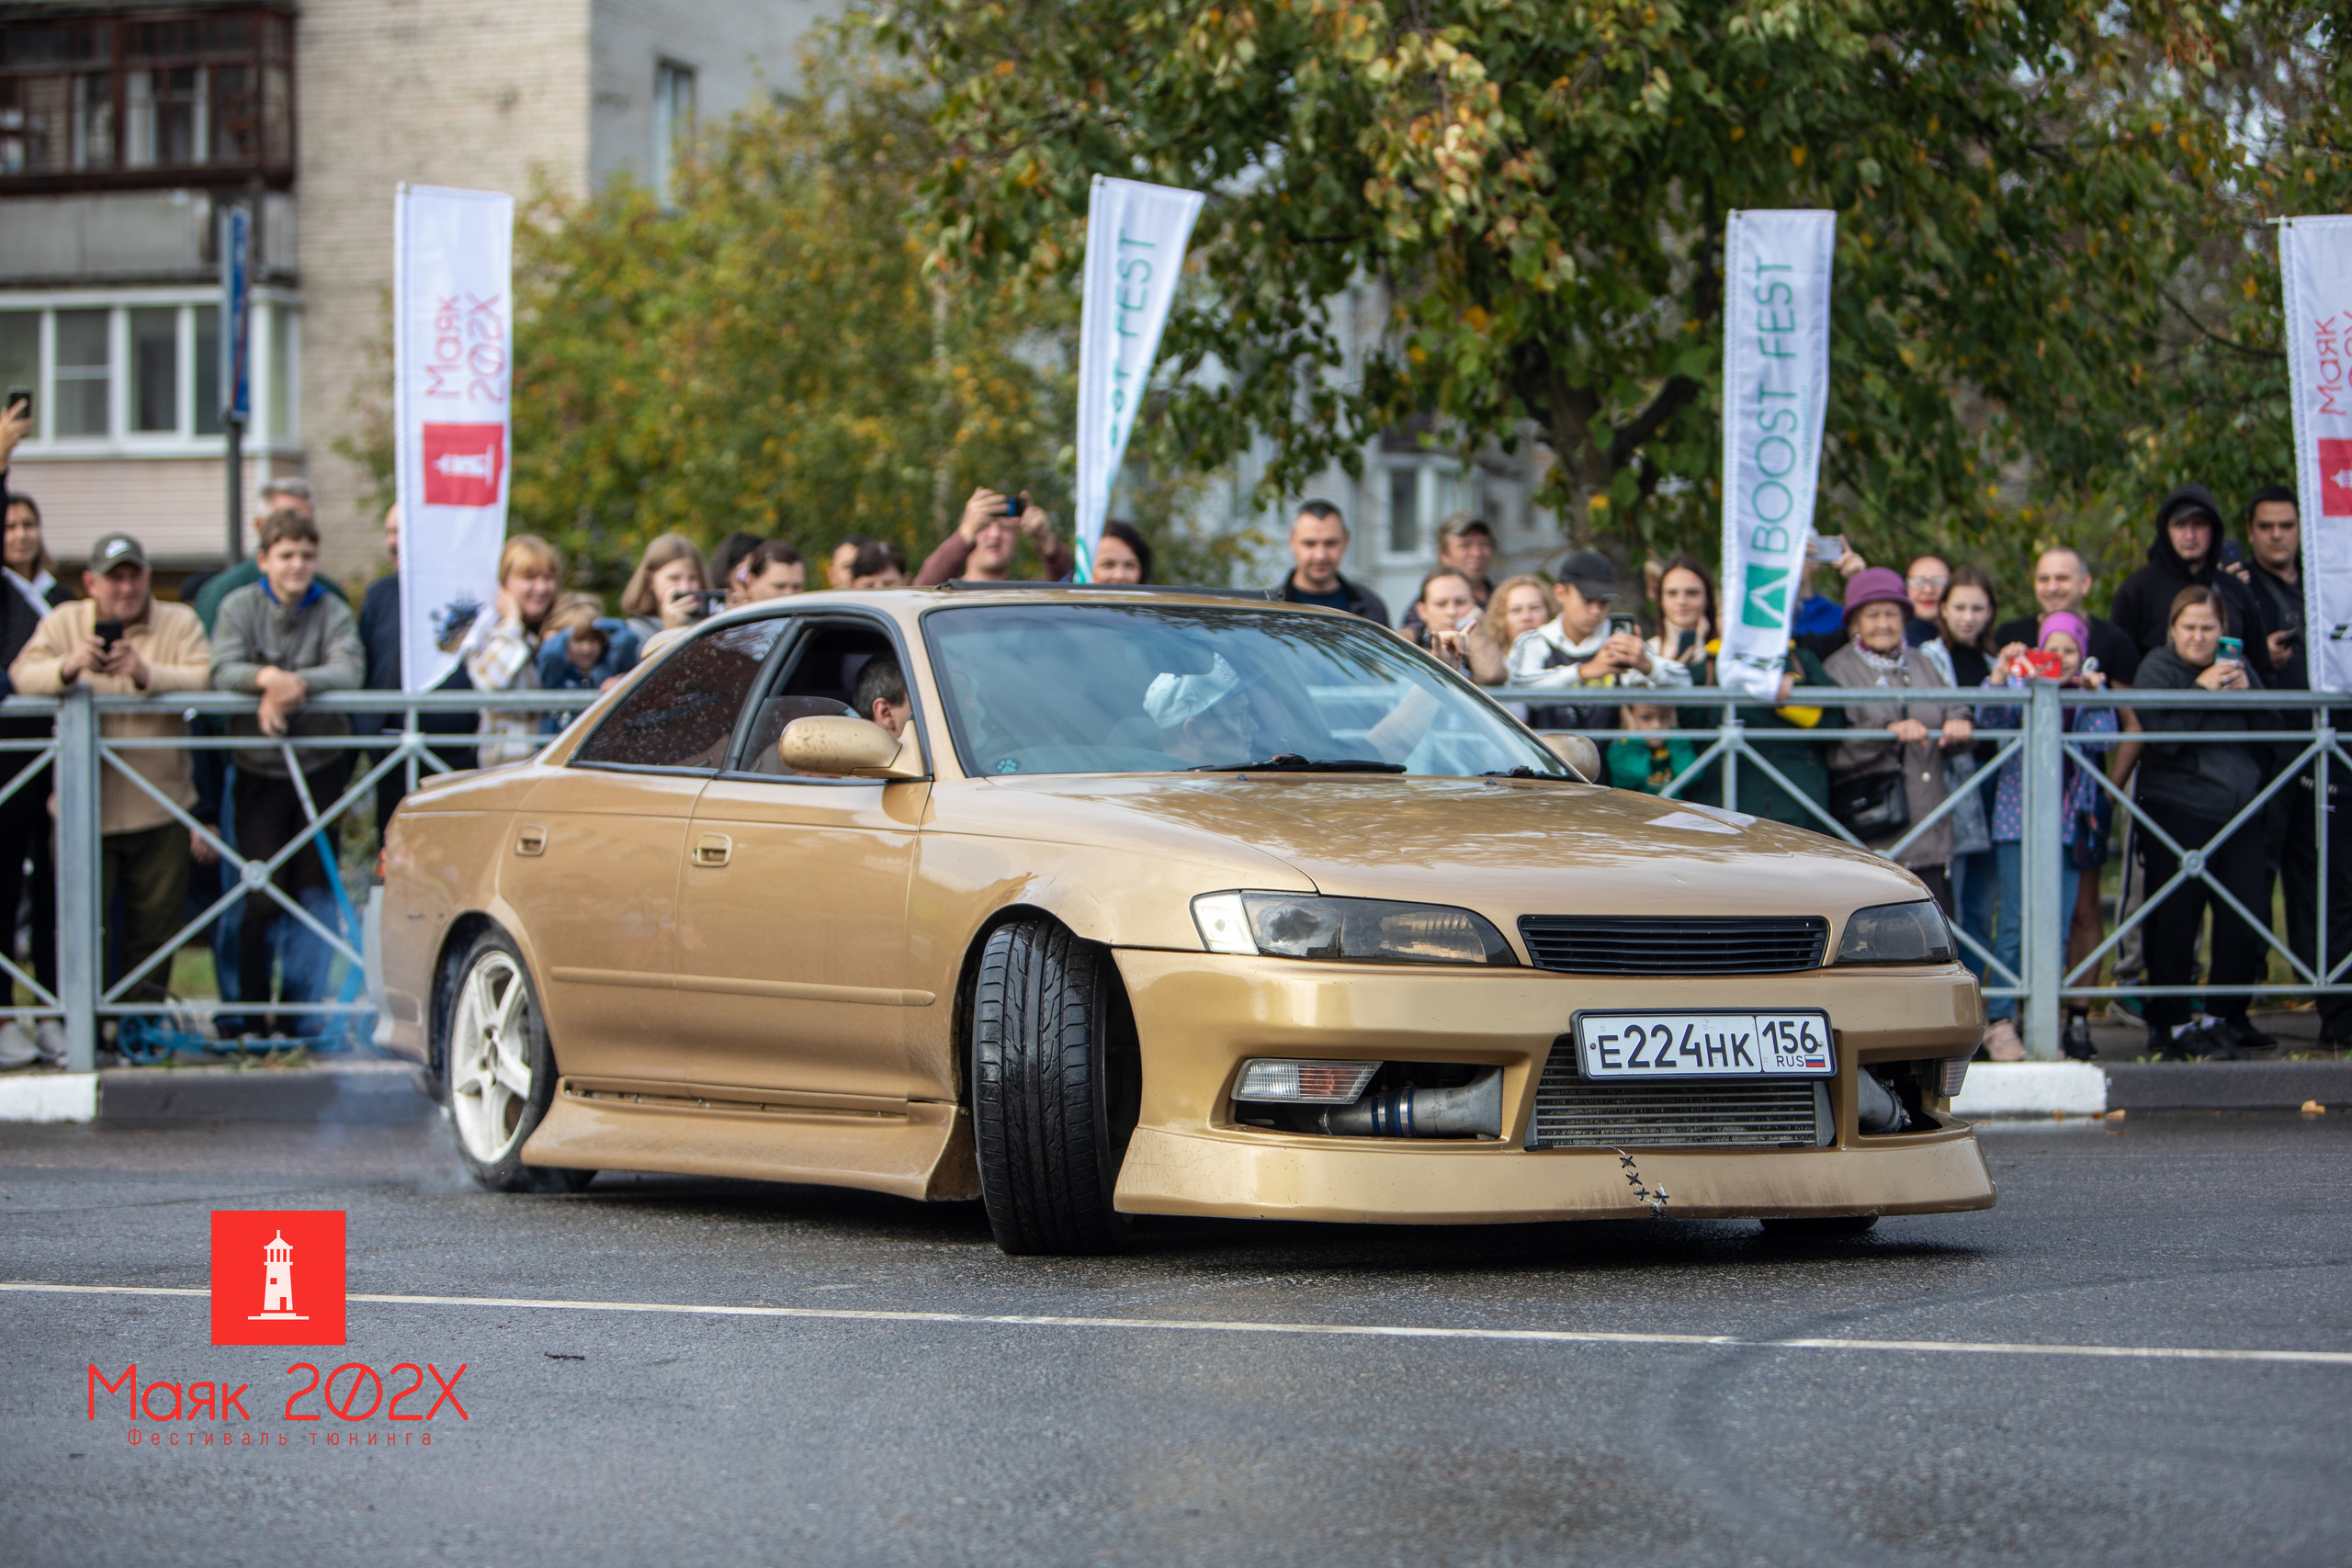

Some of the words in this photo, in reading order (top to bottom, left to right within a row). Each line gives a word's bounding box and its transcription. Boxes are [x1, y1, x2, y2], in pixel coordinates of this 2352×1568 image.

[424, 294, 462, 399] Маяк
[1755, 254, 1796, 357] FEST
[2314, 316, 2347, 416] Маяк
[1752, 380, 1798, 554] BOOST
[1761, 1020, 1817, 1055] 156
[1776, 1055, 1804, 1068] RUS
